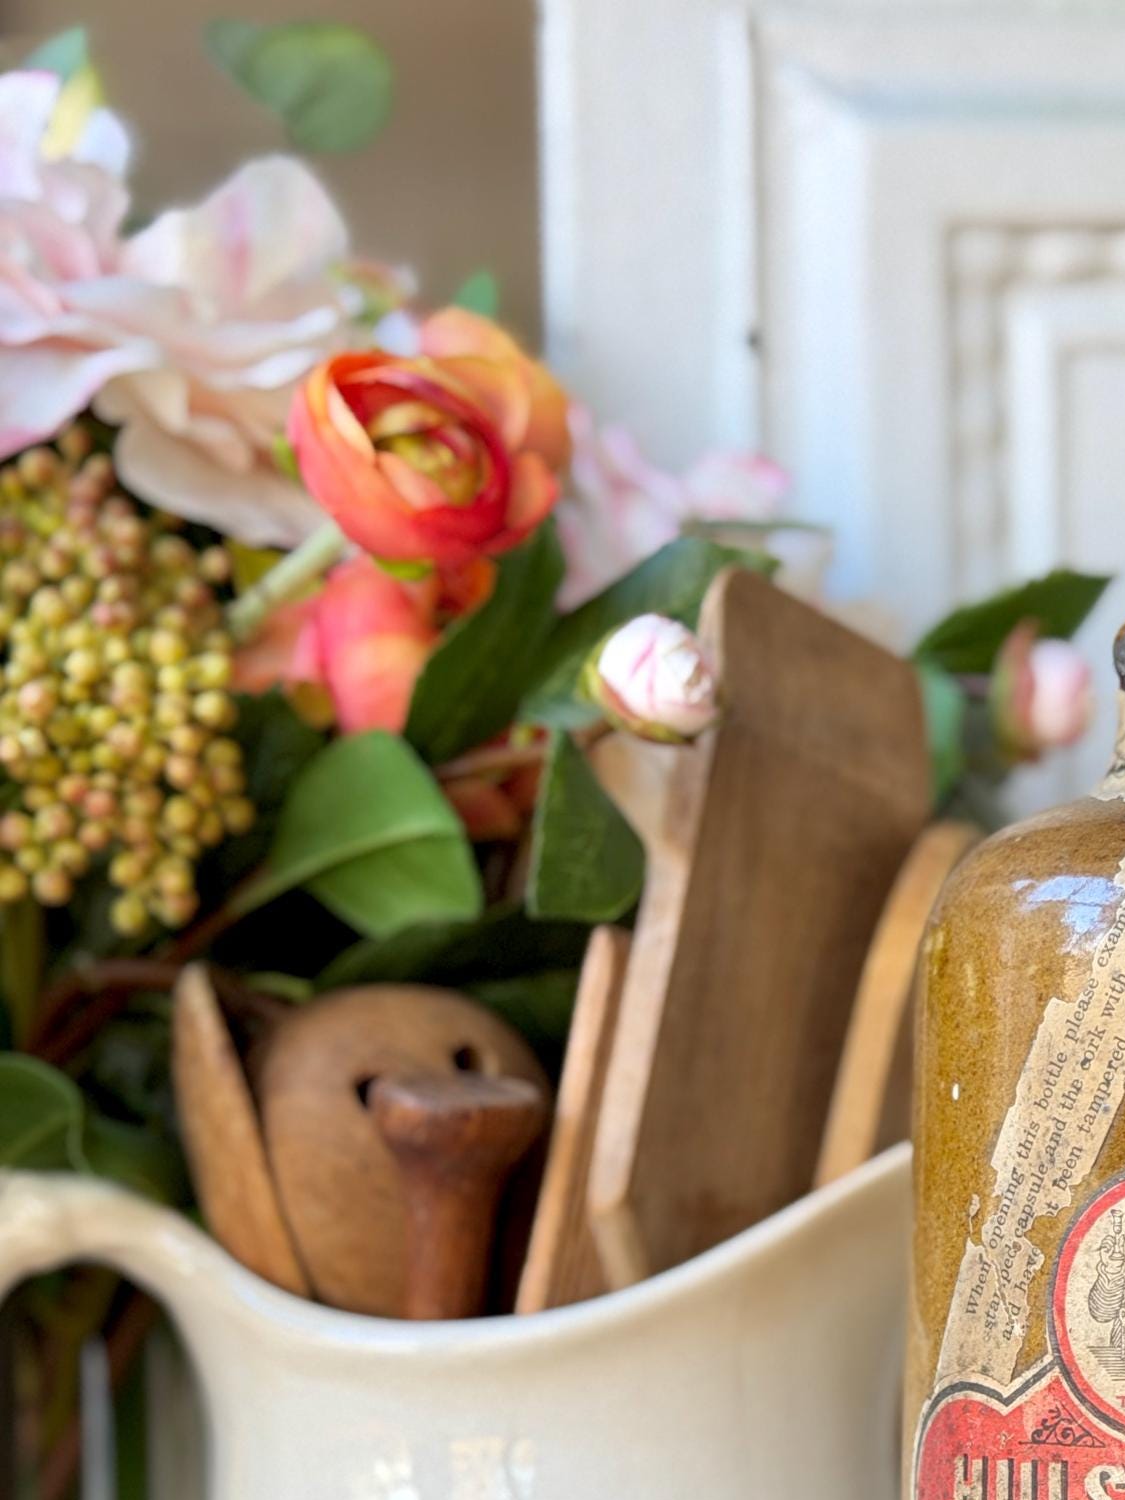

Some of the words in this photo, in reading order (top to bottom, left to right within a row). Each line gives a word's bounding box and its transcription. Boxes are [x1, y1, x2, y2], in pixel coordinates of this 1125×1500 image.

[965, 1260, 991, 1315] When
[989, 1166, 1025, 1250] opening
[1016, 1120, 1041, 1161] this
[1034, 1051, 1068, 1111] bottle
[1064, 977, 1099, 1044] please
[1014, 1163, 1048, 1238] capsule
[1045, 1117, 1067, 1157] and
[1060, 1078, 1083, 1111] the
[1081, 1025, 1106, 1071] cork
[1052, 1146, 1083, 1191] been
